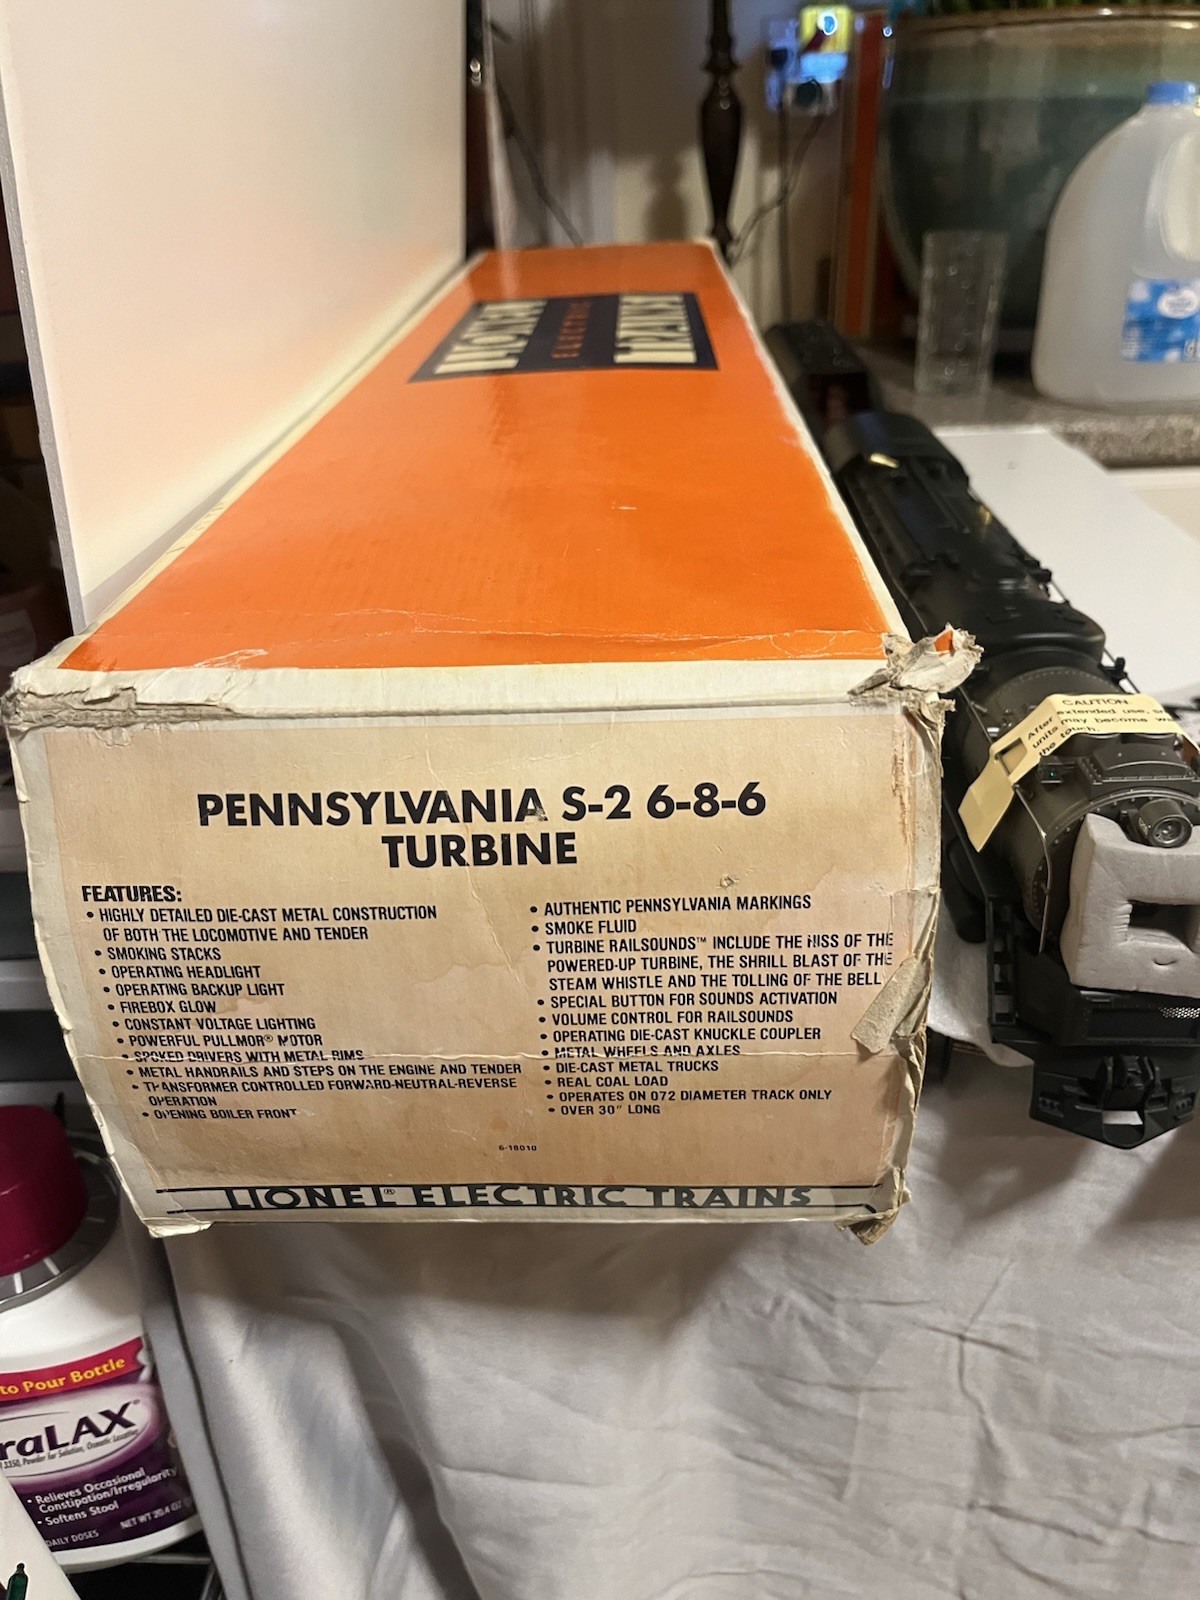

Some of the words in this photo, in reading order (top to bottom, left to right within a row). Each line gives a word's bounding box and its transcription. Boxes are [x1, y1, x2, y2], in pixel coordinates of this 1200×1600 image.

[1027, 716, 1054, 740] After
[1056, 707, 1116, 715] extended
[1032, 726, 1059, 749] units
[1060, 717, 1088, 725] may
[1038, 742, 1056, 757] the
[197, 788, 548, 826] PENNSYLVANIA
[562, 785, 631, 821] S-2
[647, 782, 766, 819] 6-8-6
[381, 832, 577, 868] TURBINE
[82, 886, 182, 902] FEATURES:
[544, 900, 621, 916] AUTHENTIC
[626, 897, 731, 913] PENNSYLVANIA
[737, 895, 811, 910] MARKINGS
[99, 908, 144, 922] HIGHLY
[150, 908, 212, 922] DETAILED
[217, 908, 277, 922] DIE-CAST
[282, 908, 329, 921] METAL
[333, 906, 436, 921] CONSTRUCTION
[103, 928, 119, 941] OF
[124, 928, 159, 941] BOTH
[162, 928, 189, 941] THE
[192, 928, 278, 942] LOCOMOTIVE
[283, 928, 311, 941] AND
[314, 927, 368, 940] TENDER
[545, 921, 593, 935] SMOKE
[598, 919, 636, 933] FLUID
[546, 940, 604, 954] TURBINE
[713, 936, 770, 949] INCLUDE
[775, 935, 802, 949] THE
[807, 934, 838, 948] HISS
[844, 934, 862, 947] OF
[867, 933, 893, 947] THE
[107, 947, 167, 960] SMOKING
[171, 947, 221, 960] STACKS
[548, 958, 636, 972] POWERED-UP
[641, 956, 702, 970] TURBINE,
[708, 955, 734, 968] THE
[740, 955, 787, 968] SHRILL
[793, 954, 839, 967] BLAST
[843, 953, 861, 967] OF
[866, 952, 892, 966] THE
[111, 966, 183, 978] OPERATING
[186, 966, 260, 978] HEADLIGHT
[549, 978, 597, 991] STEAM
[602, 975, 663, 989] WHISTLE
[668, 975, 696, 987] AND
[701, 974, 727, 987] THE
[732, 973, 788, 987] TOLLING
[794, 973, 811, 986] OF
[816, 973, 842, 986] THE
[848, 972, 881, 985] BELL
[116, 983, 187, 996] OPERATING
[191, 983, 242, 996] BACKUP
[247, 983, 285, 996] LIGHT
[120, 1001, 175, 1013] FIREBOX
[179, 1000, 216, 1013] GLOW
[551, 996, 607, 1008] SPECIAL
[612, 994, 664, 1007] BUTTON
[670, 993, 694, 1006] FOR
[699, 992, 753, 1005] SOUNDS
[759, 992, 837, 1005] ACTIVATION
[125, 1018, 191, 1030] CONSTANT
[196, 1018, 253, 1030] VOLTAGE
[256, 1018, 316, 1030] LIGHTING
[552, 1013, 607, 1025] VOLUME
[611, 1011, 672, 1024] CONTROL
[678, 1011, 702, 1023] FOR
[708, 1010, 793, 1023] RAILSOUNDS
[129, 1035, 200, 1046] POWERFUL
[277, 1034, 323, 1046] MOTOR
[553, 1030, 625, 1042] OPERATING
[630, 1028, 689, 1041] DIE-CAST
[694, 1028, 755, 1040] KNUCKLE
[760, 1028, 821, 1040] COUPLER
[134, 1051, 184, 1062] SPOKED
[187, 1051, 242, 1064] DRIVERS
[244, 1051, 280, 1063] WITH
[284, 1050, 328, 1062] METAL
[331, 1050, 364, 1060] RIMS
[555, 1047, 599, 1059] METAL
[603, 1045, 658, 1058] WHEELS
[663, 1045, 692, 1057] AND
[696, 1045, 740, 1057] AXLES
[138, 1067, 182, 1077] METAL
[185, 1066, 258, 1077] HANDRAILS
[264, 1066, 290, 1077] AND
[293, 1065, 334, 1076] STEPS
[338, 1065, 356, 1076] ON
[359, 1065, 385, 1075] THE
[389, 1064, 435, 1075] ENGINE
[440, 1064, 466, 1074] AND
[471, 1064, 521, 1074] TENDER
[556, 1062, 614, 1073] DIE-CAST
[619, 1061, 662, 1072] METAL
[667, 1060, 718, 1071] TRUCKS
[241, 1081, 324, 1092] CONTROLLED
[328, 1078, 517, 1090] FORWARD-NEUTRAL-REVERSE
[557, 1077, 591, 1087] REAL
[596, 1076, 630, 1087] COAL
[635, 1076, 668, 1086] LOAD
[559, 1091, 624, 1102] OPERATES
[629, 1091, 646, 1101] ON
[681, 1090, 746, 1100] DIAMETER
[751, 1090, 794, 1100] TRACK
[799, 1090, 832, 1100] ONLY
[210, 1110, 254, 1119] BOILER
[257, 1109, 297, 1118] FRONT
[561, 1106, 594, 1115] OVER
[628, 1105, 660, 1114] LONG
[498, 1144, 537, 1152] 6-18010
[414, 1184, 626, 1208] ELECTRIC
[645, 1186, 812, 1208] TRAINS
[22, 1376, 66, 1393] Pour
[69, 1358, 126, 1383] Bottle
[35, 1487, 82, 1505] Relieves
[83, 1467, 147, 1493] Occasional
[38, 1467, 178, 1514] Constipation/Irregularity
[45, 1509, 87, 1526] Softens
[89, 1501, 120, 1517] Stool
[120, 1517, 137, 1529] NET
[71, 1529, 99, 1542] DOSES
